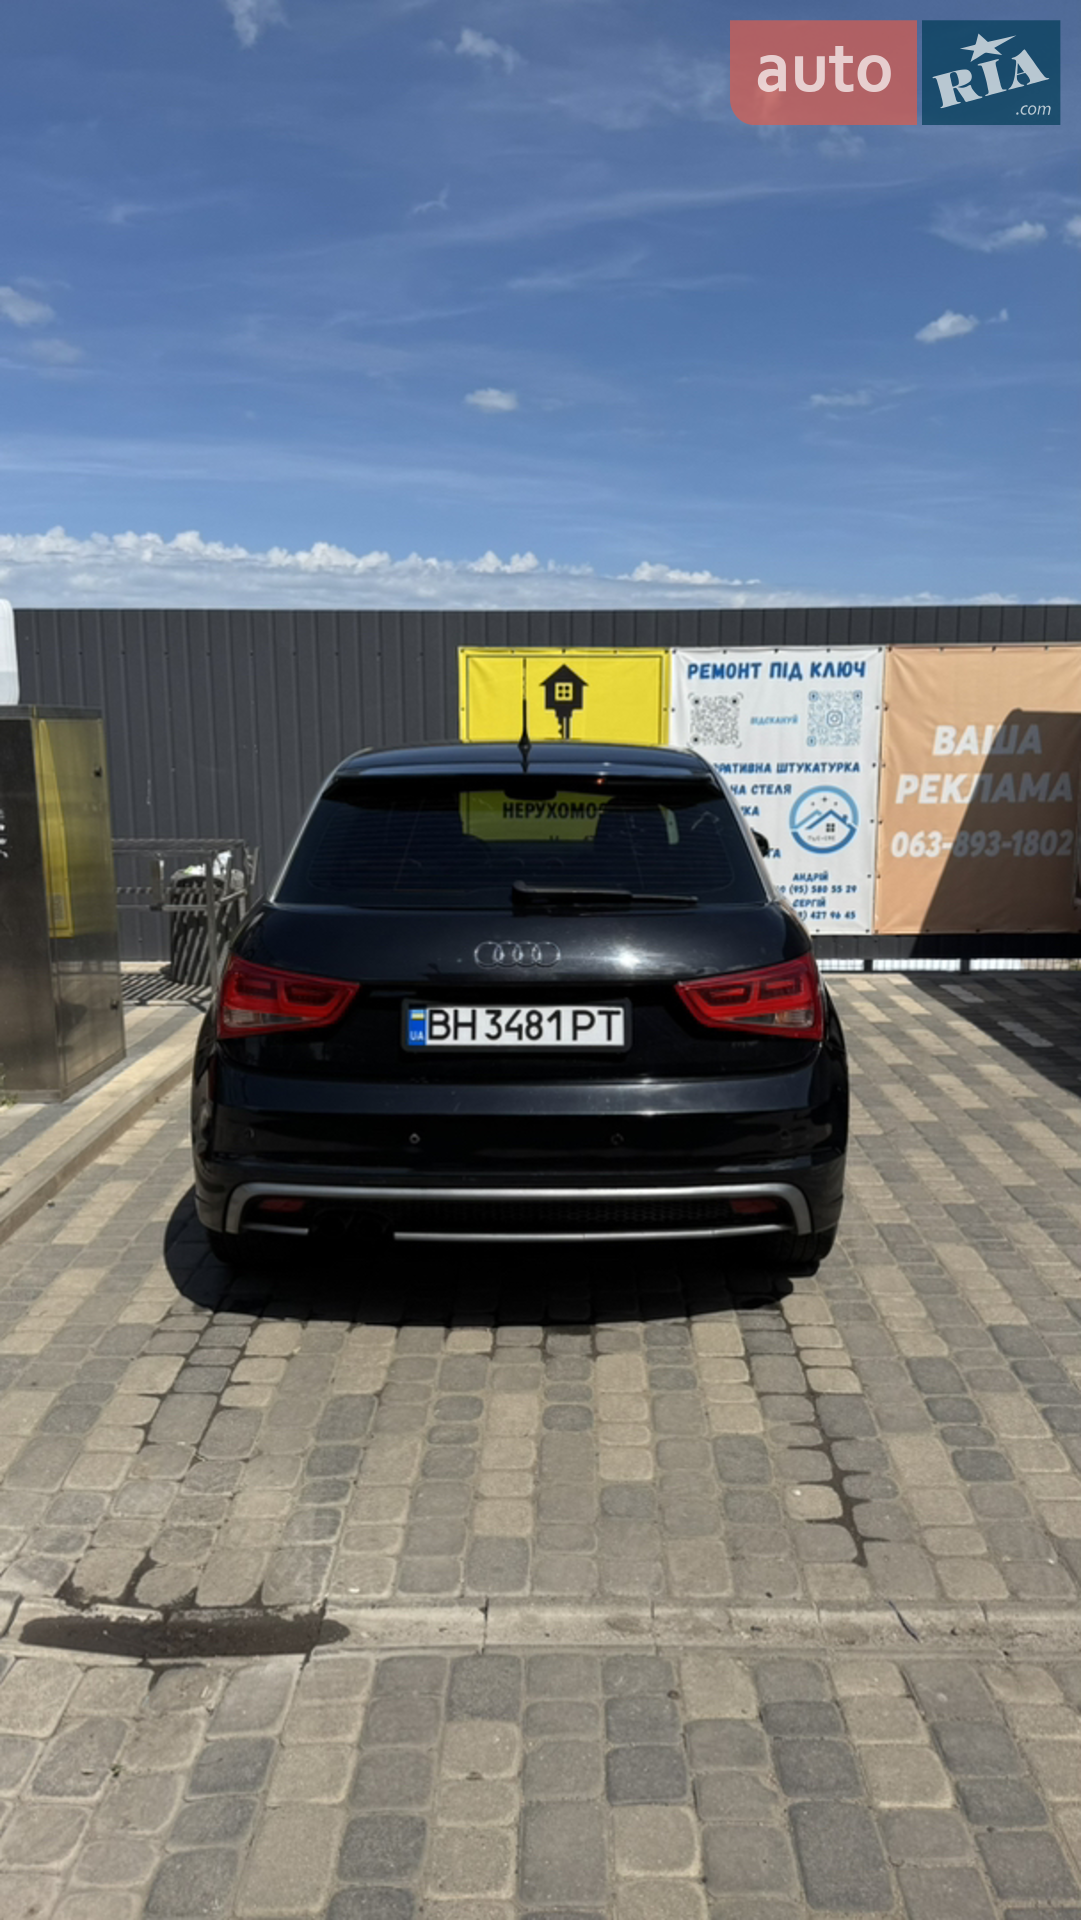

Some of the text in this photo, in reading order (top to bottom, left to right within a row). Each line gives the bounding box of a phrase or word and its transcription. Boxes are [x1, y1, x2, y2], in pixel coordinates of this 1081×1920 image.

[687, 661, 866, 681] РЕМОНТ ПІД КЛЮЧ
[932, 724, 1043, 757] ВАША
[776, 761, 860, 773] ШТУКАТУРКА
[750, 783, 792, 795] СТЕЛЯ
[895, 771, 1073, 805] РЕКЛАМА
[890, 828, 1074, 858] 063-893-1802
[792, 870, 829, 882] АНДРІЙ
[789, 884, 808, 895] (95)
[831, 885, 842, 893] 55
[845, 885, 857, 893] 29
[792, 897, 826, 907] СЕРГІЙ
[810, 911, 827, 920] 427
[830, 911, 841, 919] 96
[844, 911, 856, 919] 45
[410, 1031, 425, 1041] UA
